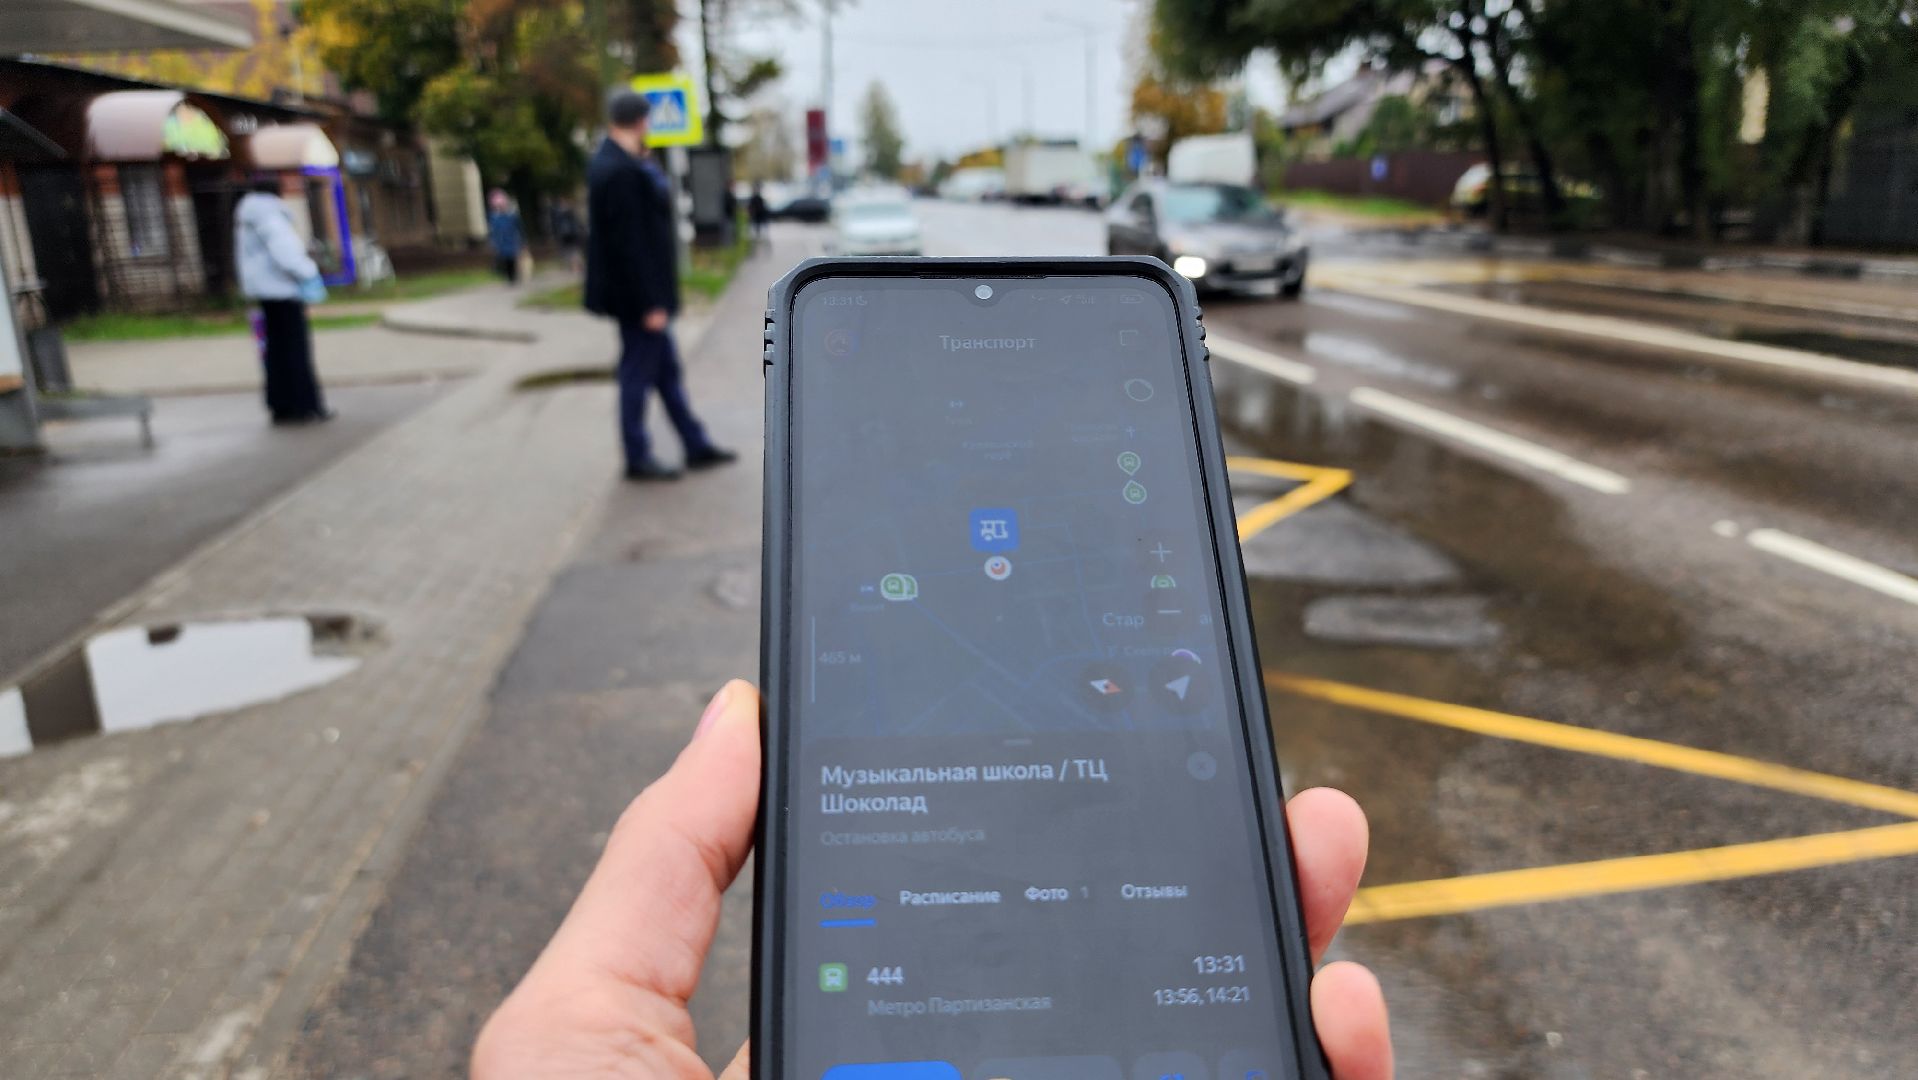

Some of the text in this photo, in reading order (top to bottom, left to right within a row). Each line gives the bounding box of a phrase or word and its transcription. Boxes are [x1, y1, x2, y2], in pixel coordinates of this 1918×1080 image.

[938, 334, 1039, 352] Транспорт
[821, 758, 1110, 788] Музыкальная школа / ТЦ
[821, 792, 929, 816] Шоколад
[820, 826, 986, 847] Остановка автобуса
[899, 889, 1001, 907] Расписание
[1024, 886, 1070, 902] Фото
[1121, 883, 1188, 900] Отзывы
[1192, 953, 1247, 975] 13:31
[867, 965, 905, 986] 444
[867, 996, 1052, 1019] Метро Партизанская
